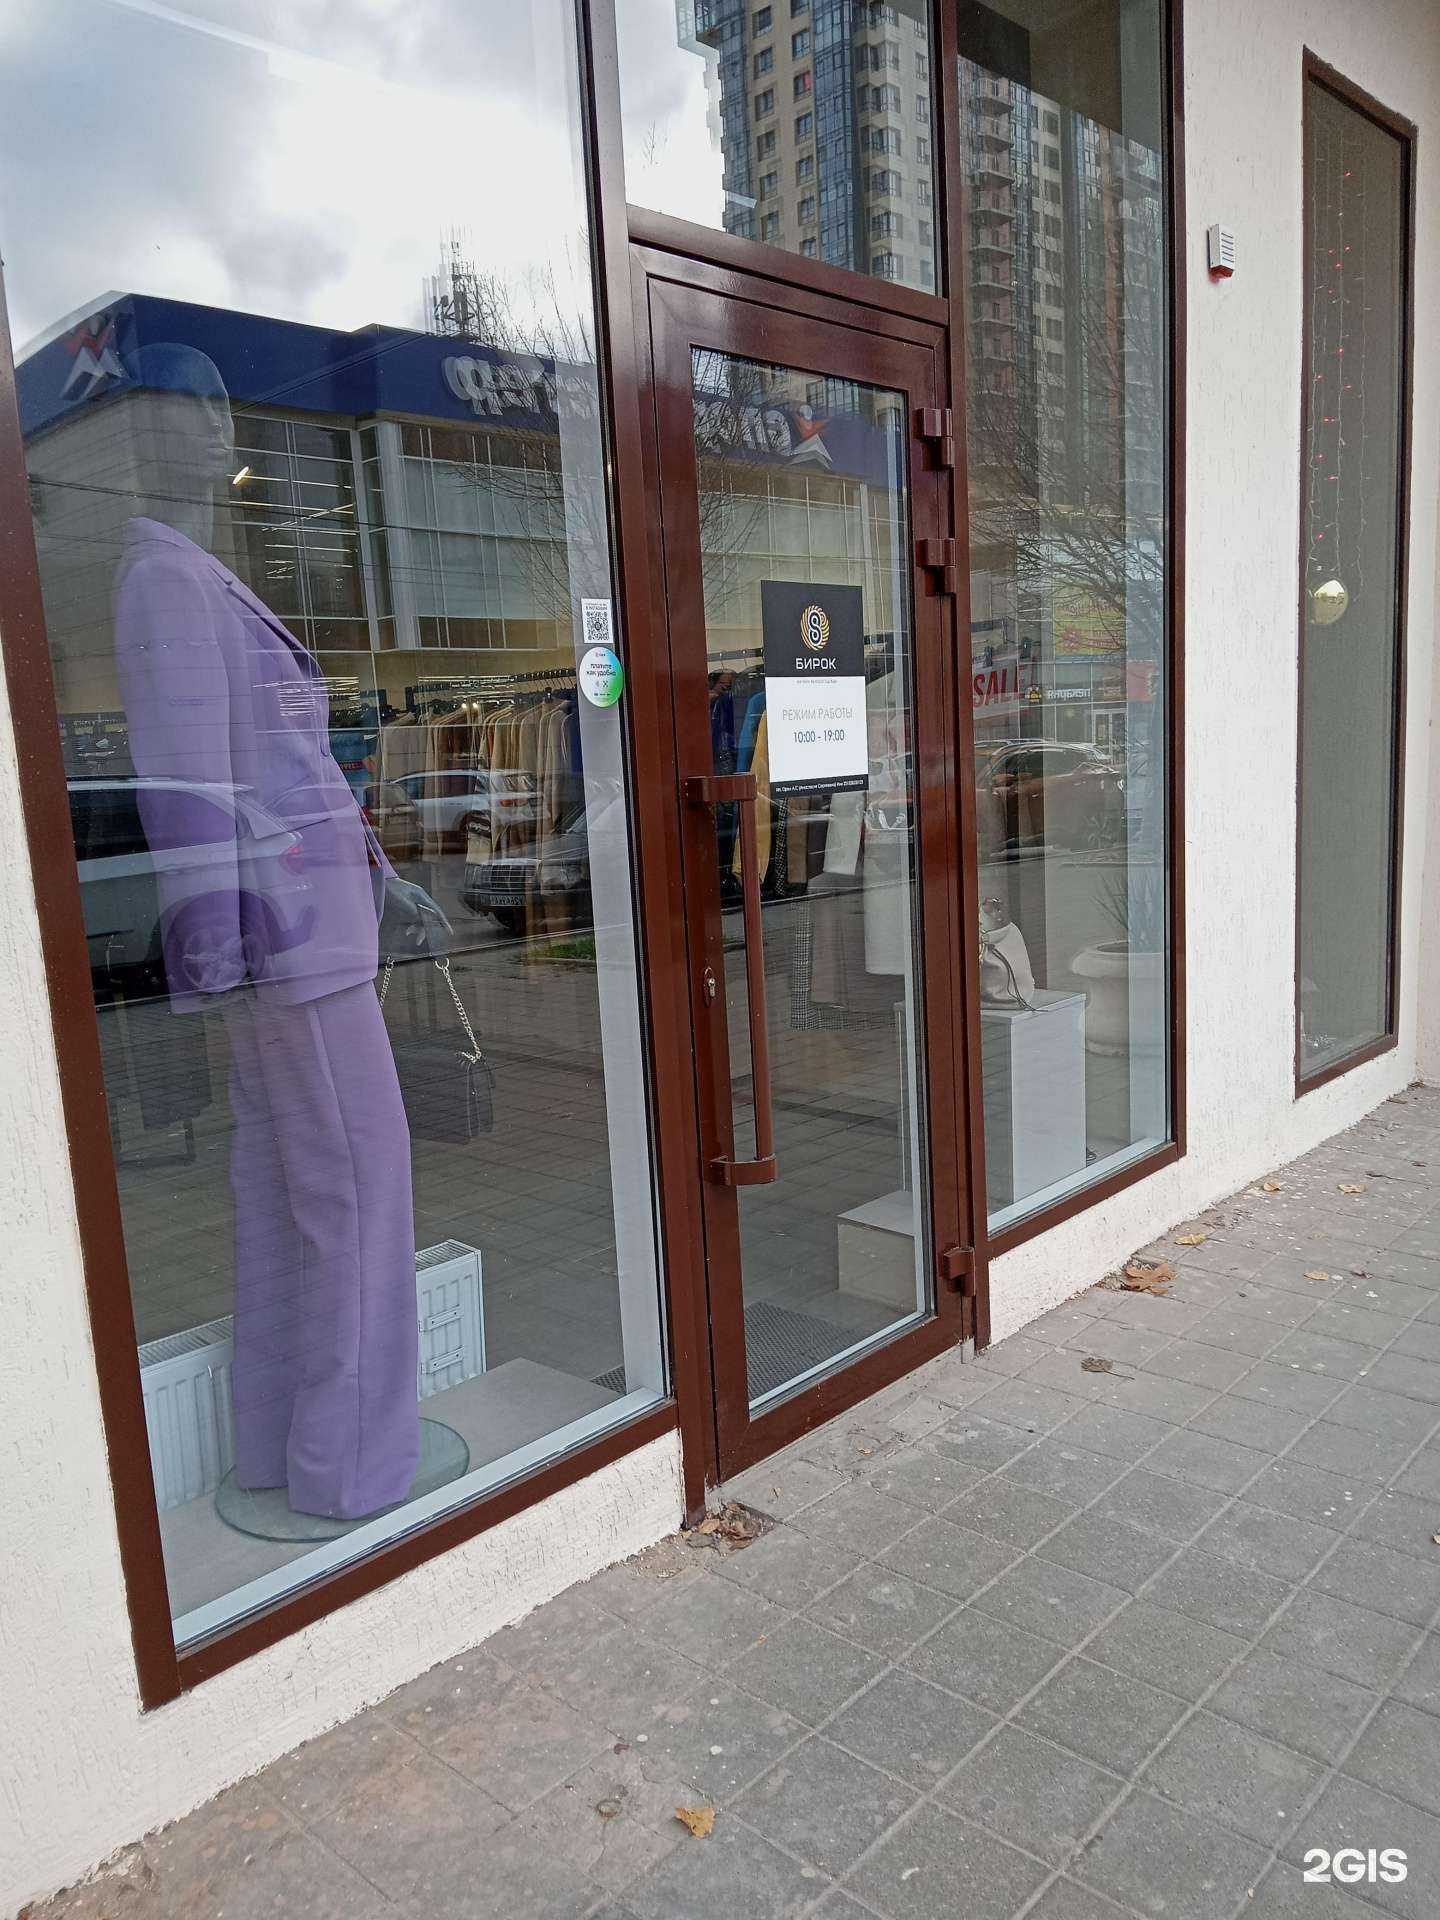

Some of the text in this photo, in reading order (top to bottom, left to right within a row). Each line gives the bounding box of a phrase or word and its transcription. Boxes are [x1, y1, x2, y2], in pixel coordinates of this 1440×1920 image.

[795, 657, 836, 670] БИРОК
[782, 707, 853, 721] РЕЖИМ РАБОТЫ
[793, 730, 816, 743] 10:00
[823, 729, 845, 742] 19:00
